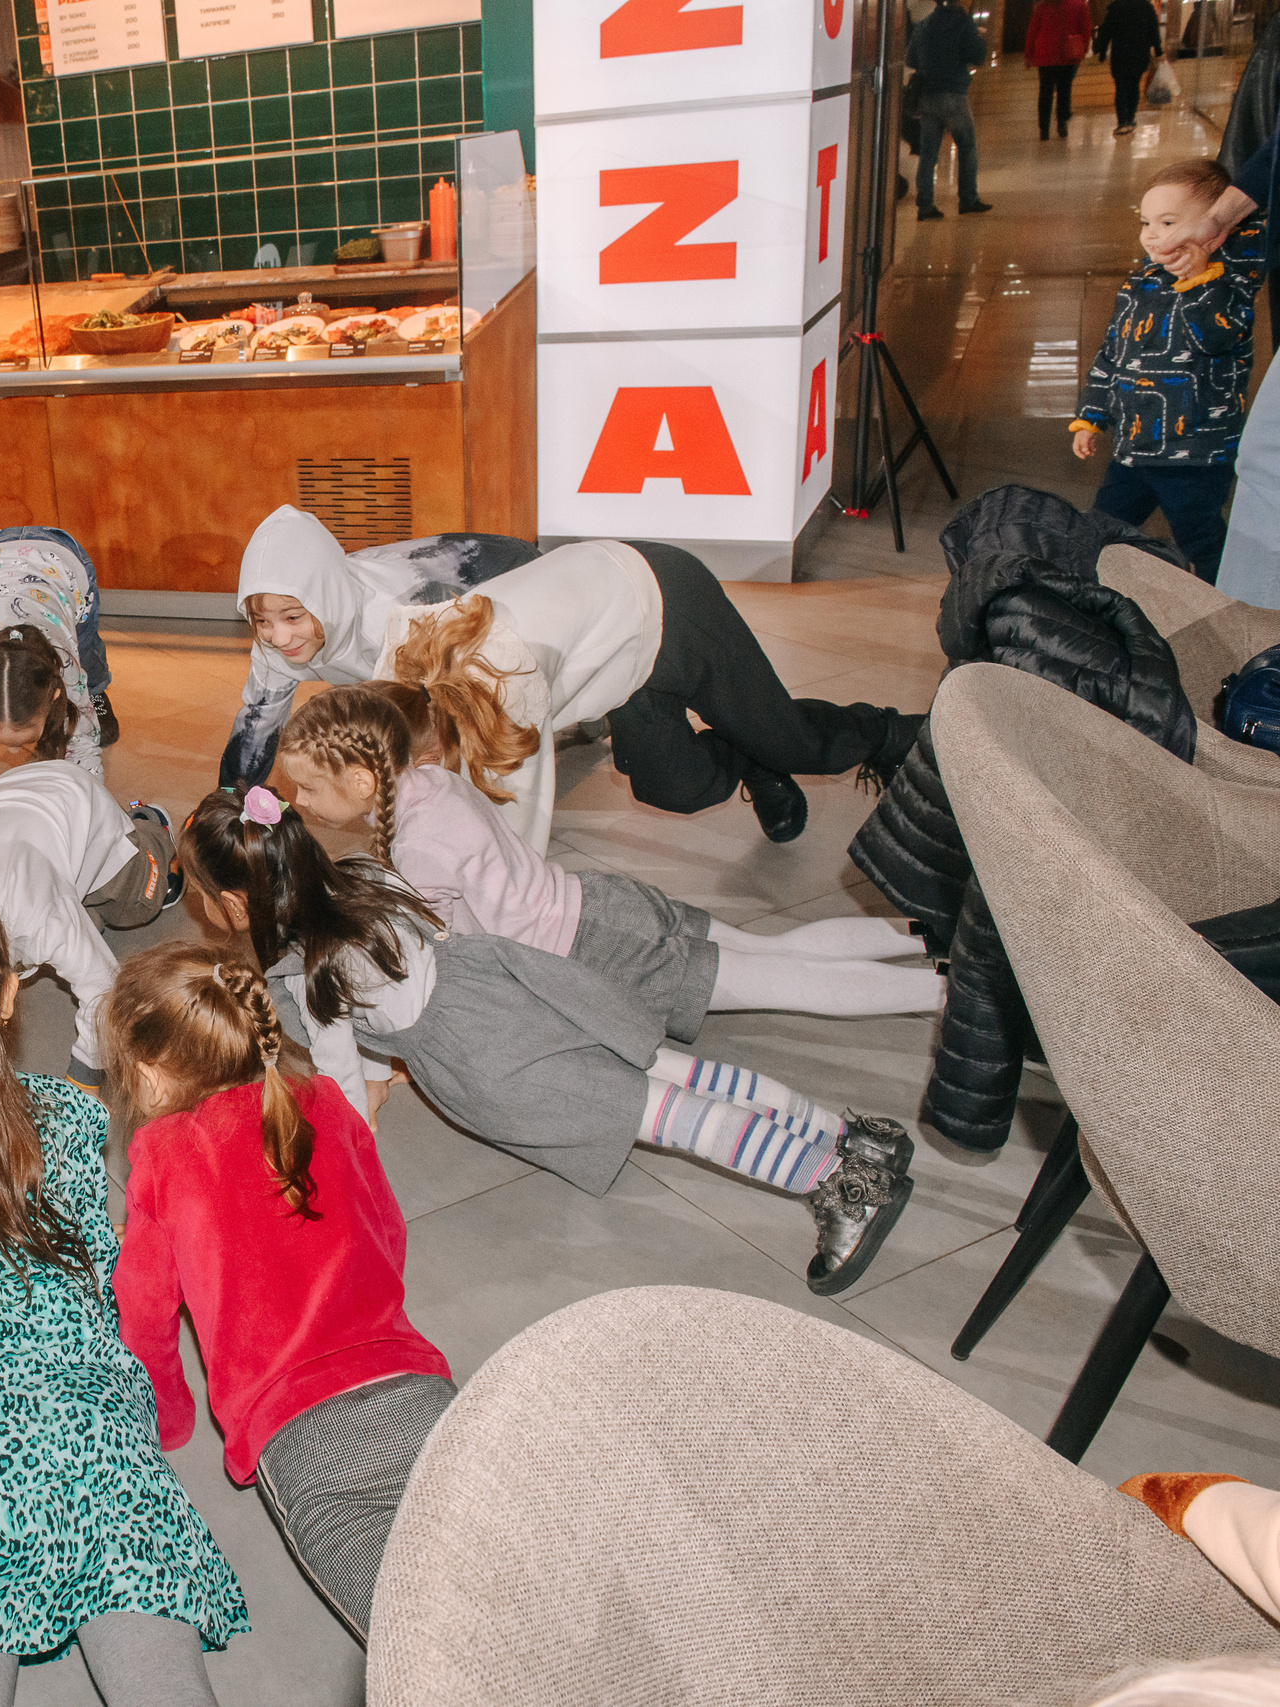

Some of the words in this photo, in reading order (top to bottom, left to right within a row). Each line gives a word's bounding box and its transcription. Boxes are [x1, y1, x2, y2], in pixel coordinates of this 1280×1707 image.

[200, 4, 236, 14] ТИРАМИСУ
[200, 19, 230, 28] КАПРЕЗЕ
[62, 36, 96, 47] ПЕПЕРОНИ
